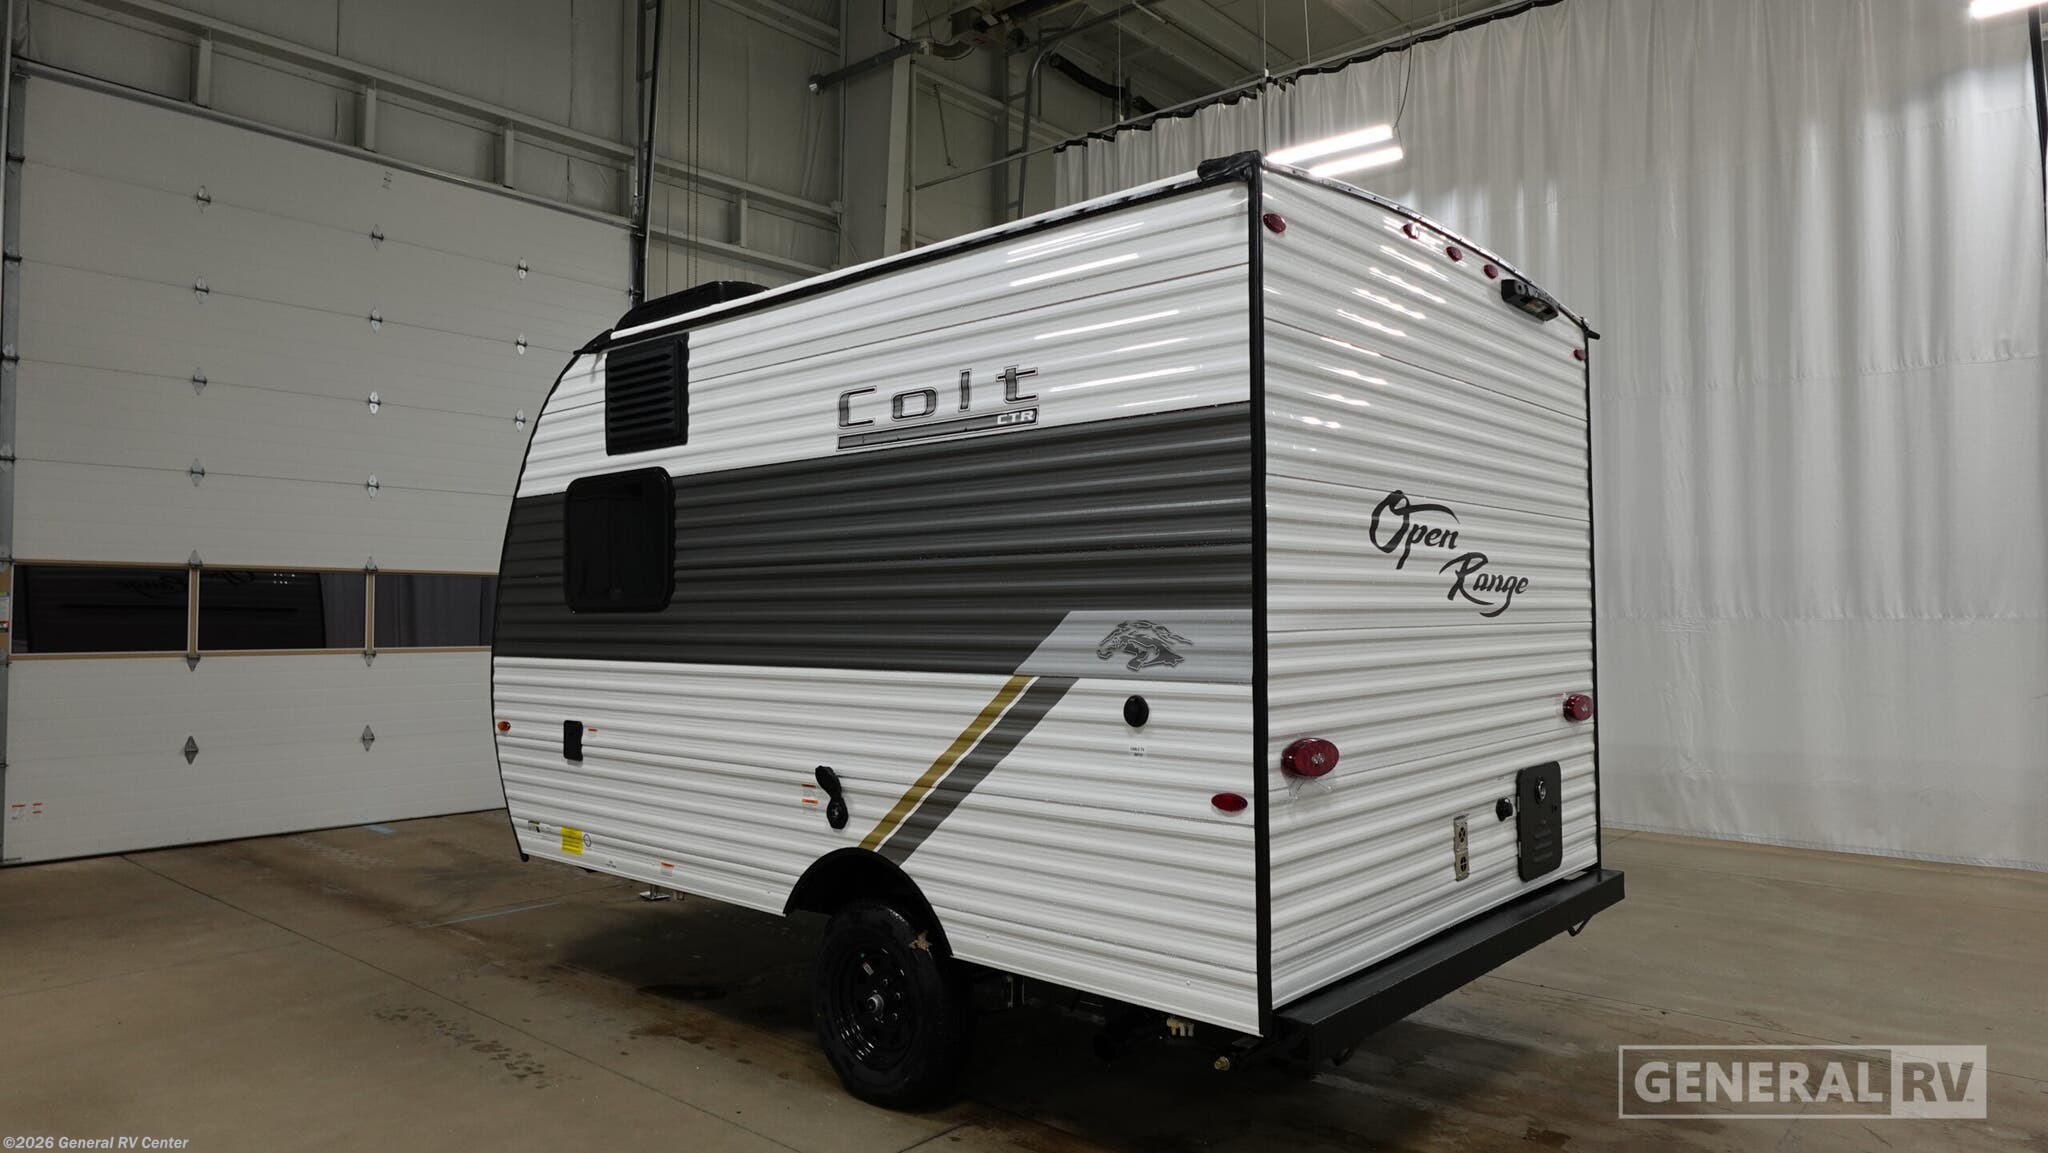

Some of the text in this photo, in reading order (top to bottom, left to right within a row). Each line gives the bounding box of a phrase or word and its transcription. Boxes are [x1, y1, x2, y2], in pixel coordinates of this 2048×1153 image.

[838, 364, 1038, 429] Colt
[997, 410, 1035, 425] CTR
[1369, 490, 1460, 570] Open
[1439, 552, 1529, 618] Range
